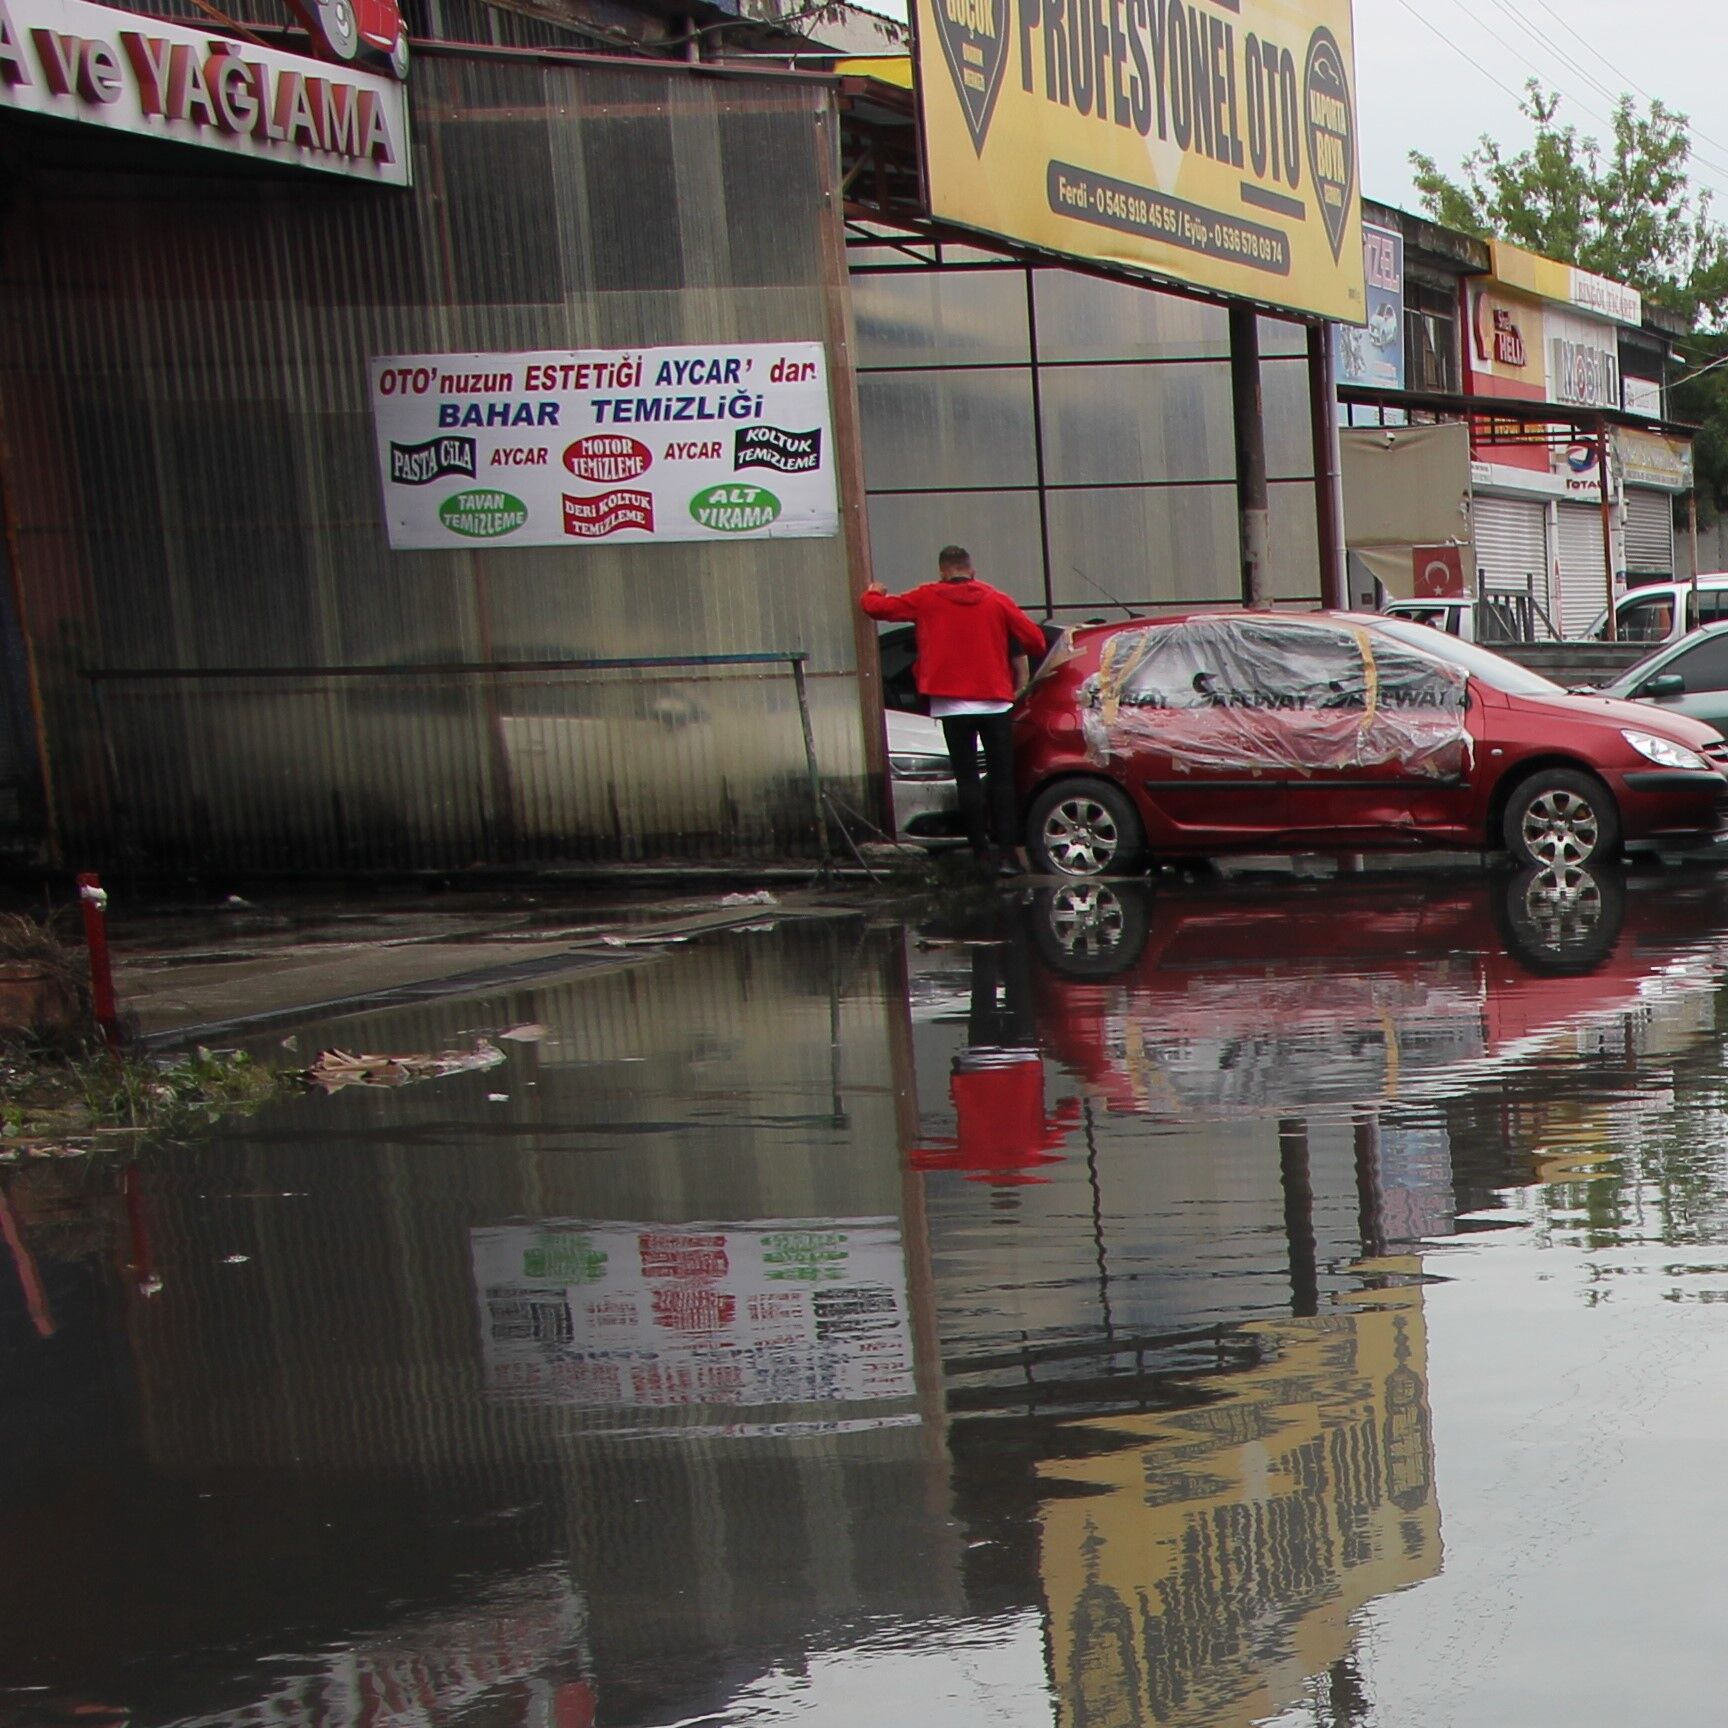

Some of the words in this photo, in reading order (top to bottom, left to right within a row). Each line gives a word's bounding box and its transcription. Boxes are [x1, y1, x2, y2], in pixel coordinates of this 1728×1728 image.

[30, 28, 123, 103] ve
[119, 31, 396, 164] YAĞLAMA
[1018, 0, 1244, 169] PROFESYONEL
[1245, 31, 1300, 190] OTO
[1310, 88, 1347, 136] KAPORTA
[1316, 130, 1346, 185] BOYA
[1059, 176, 1087, 209] Ferdi
[1105, 191, 1127, 219] 545
[1128, 198, 1147, 224] 918
[1149, 203, 1163, 230] 45
[1163, 207, 1176, 233] 55
[1184, 214, 1208, 248] Eyüp
[438, 402, 560, 427] BAHAR
[582, 438, 632, 455] MOTOR
[664, 441, 722, 460] AYCAR
[746, 427, 812, 453] KOLTUK
[393, 447, 439, 481] PASTA
[490, 448, 548, 465] AYCAR
[457, 494, 505, 511] TAVAN
[599, 494, 651, 515] KOLTUK
[709, 489, 762, 505] ALT
[699, 507, 774, 530] YIKAMA
